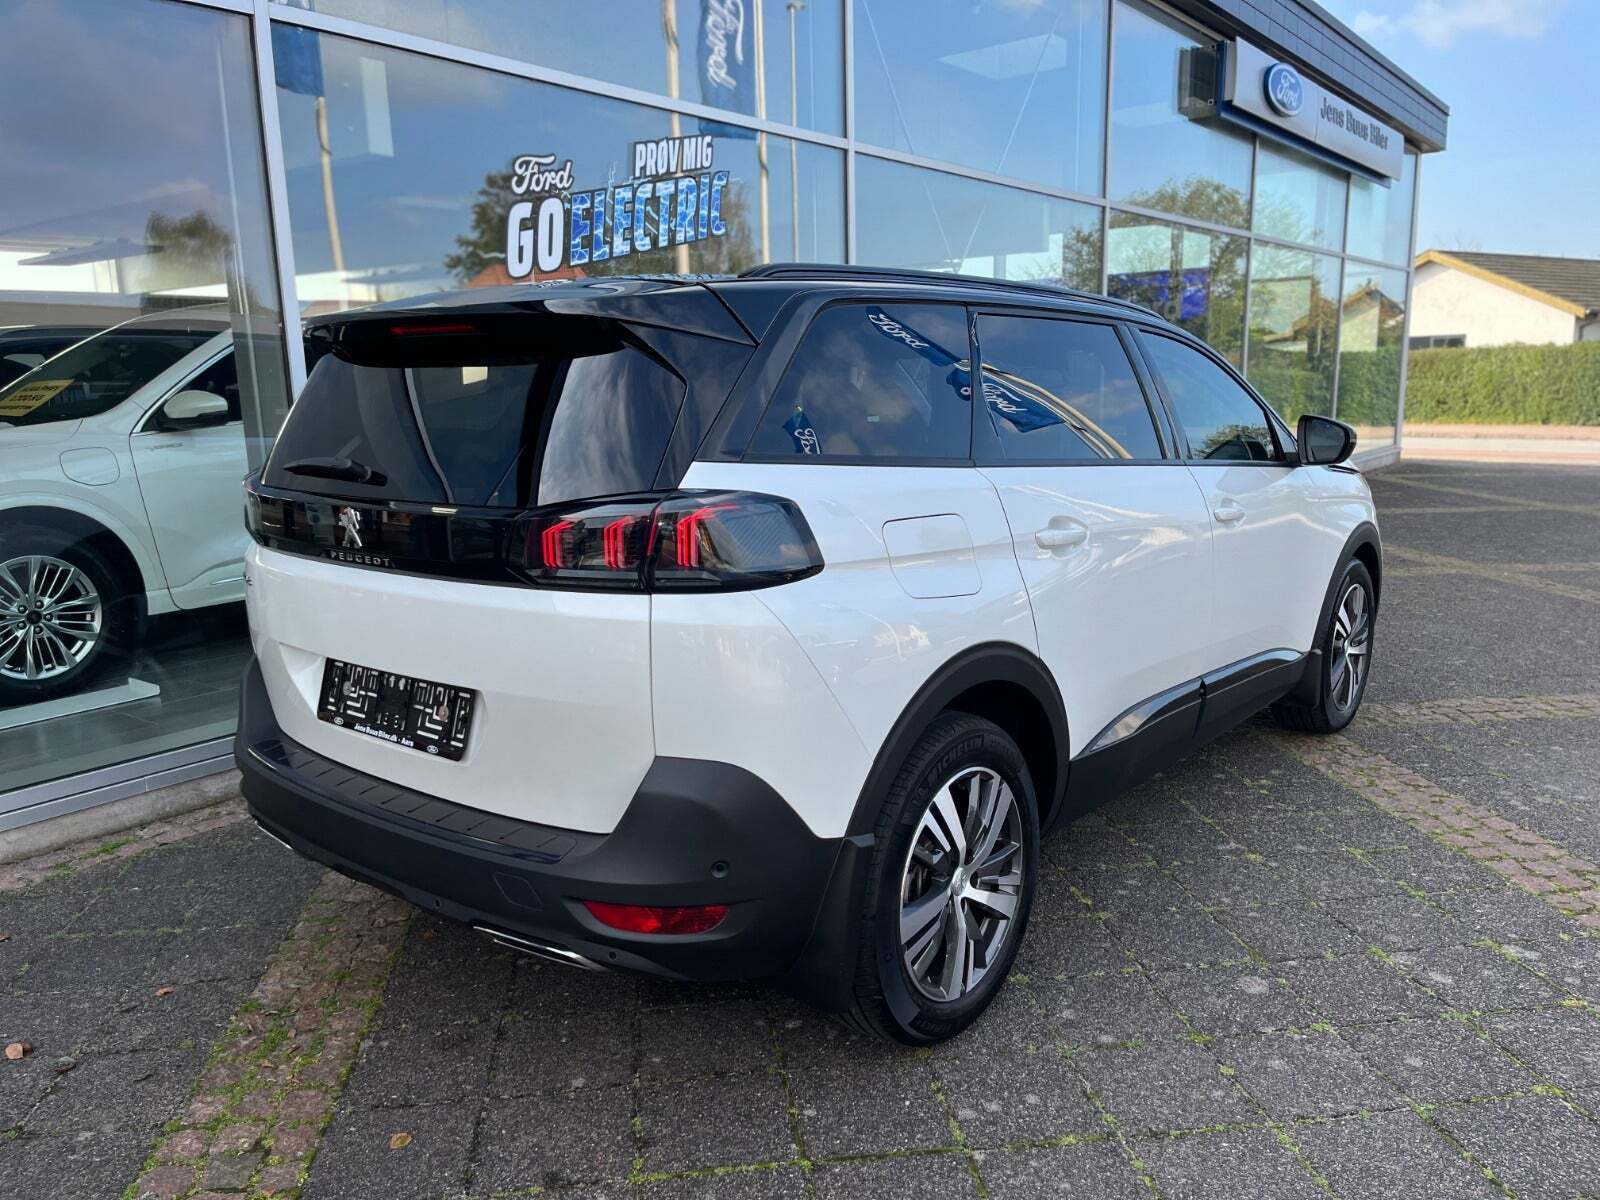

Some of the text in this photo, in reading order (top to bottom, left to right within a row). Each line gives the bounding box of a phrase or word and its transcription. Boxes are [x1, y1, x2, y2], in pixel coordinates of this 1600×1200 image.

[1320, 97, 1389, 150] Jens Buus Biler
[511, 154, 574, 195] Ford
[635, 135, 713, 178] PRØV MIG
[507, 171, 730, 279] GO ELECTRIC
[868, 313, 930, 349] Ford
[330, 550, 390, 567] PEUGEOT
[927, 737, 984, 784] MICHELIN
